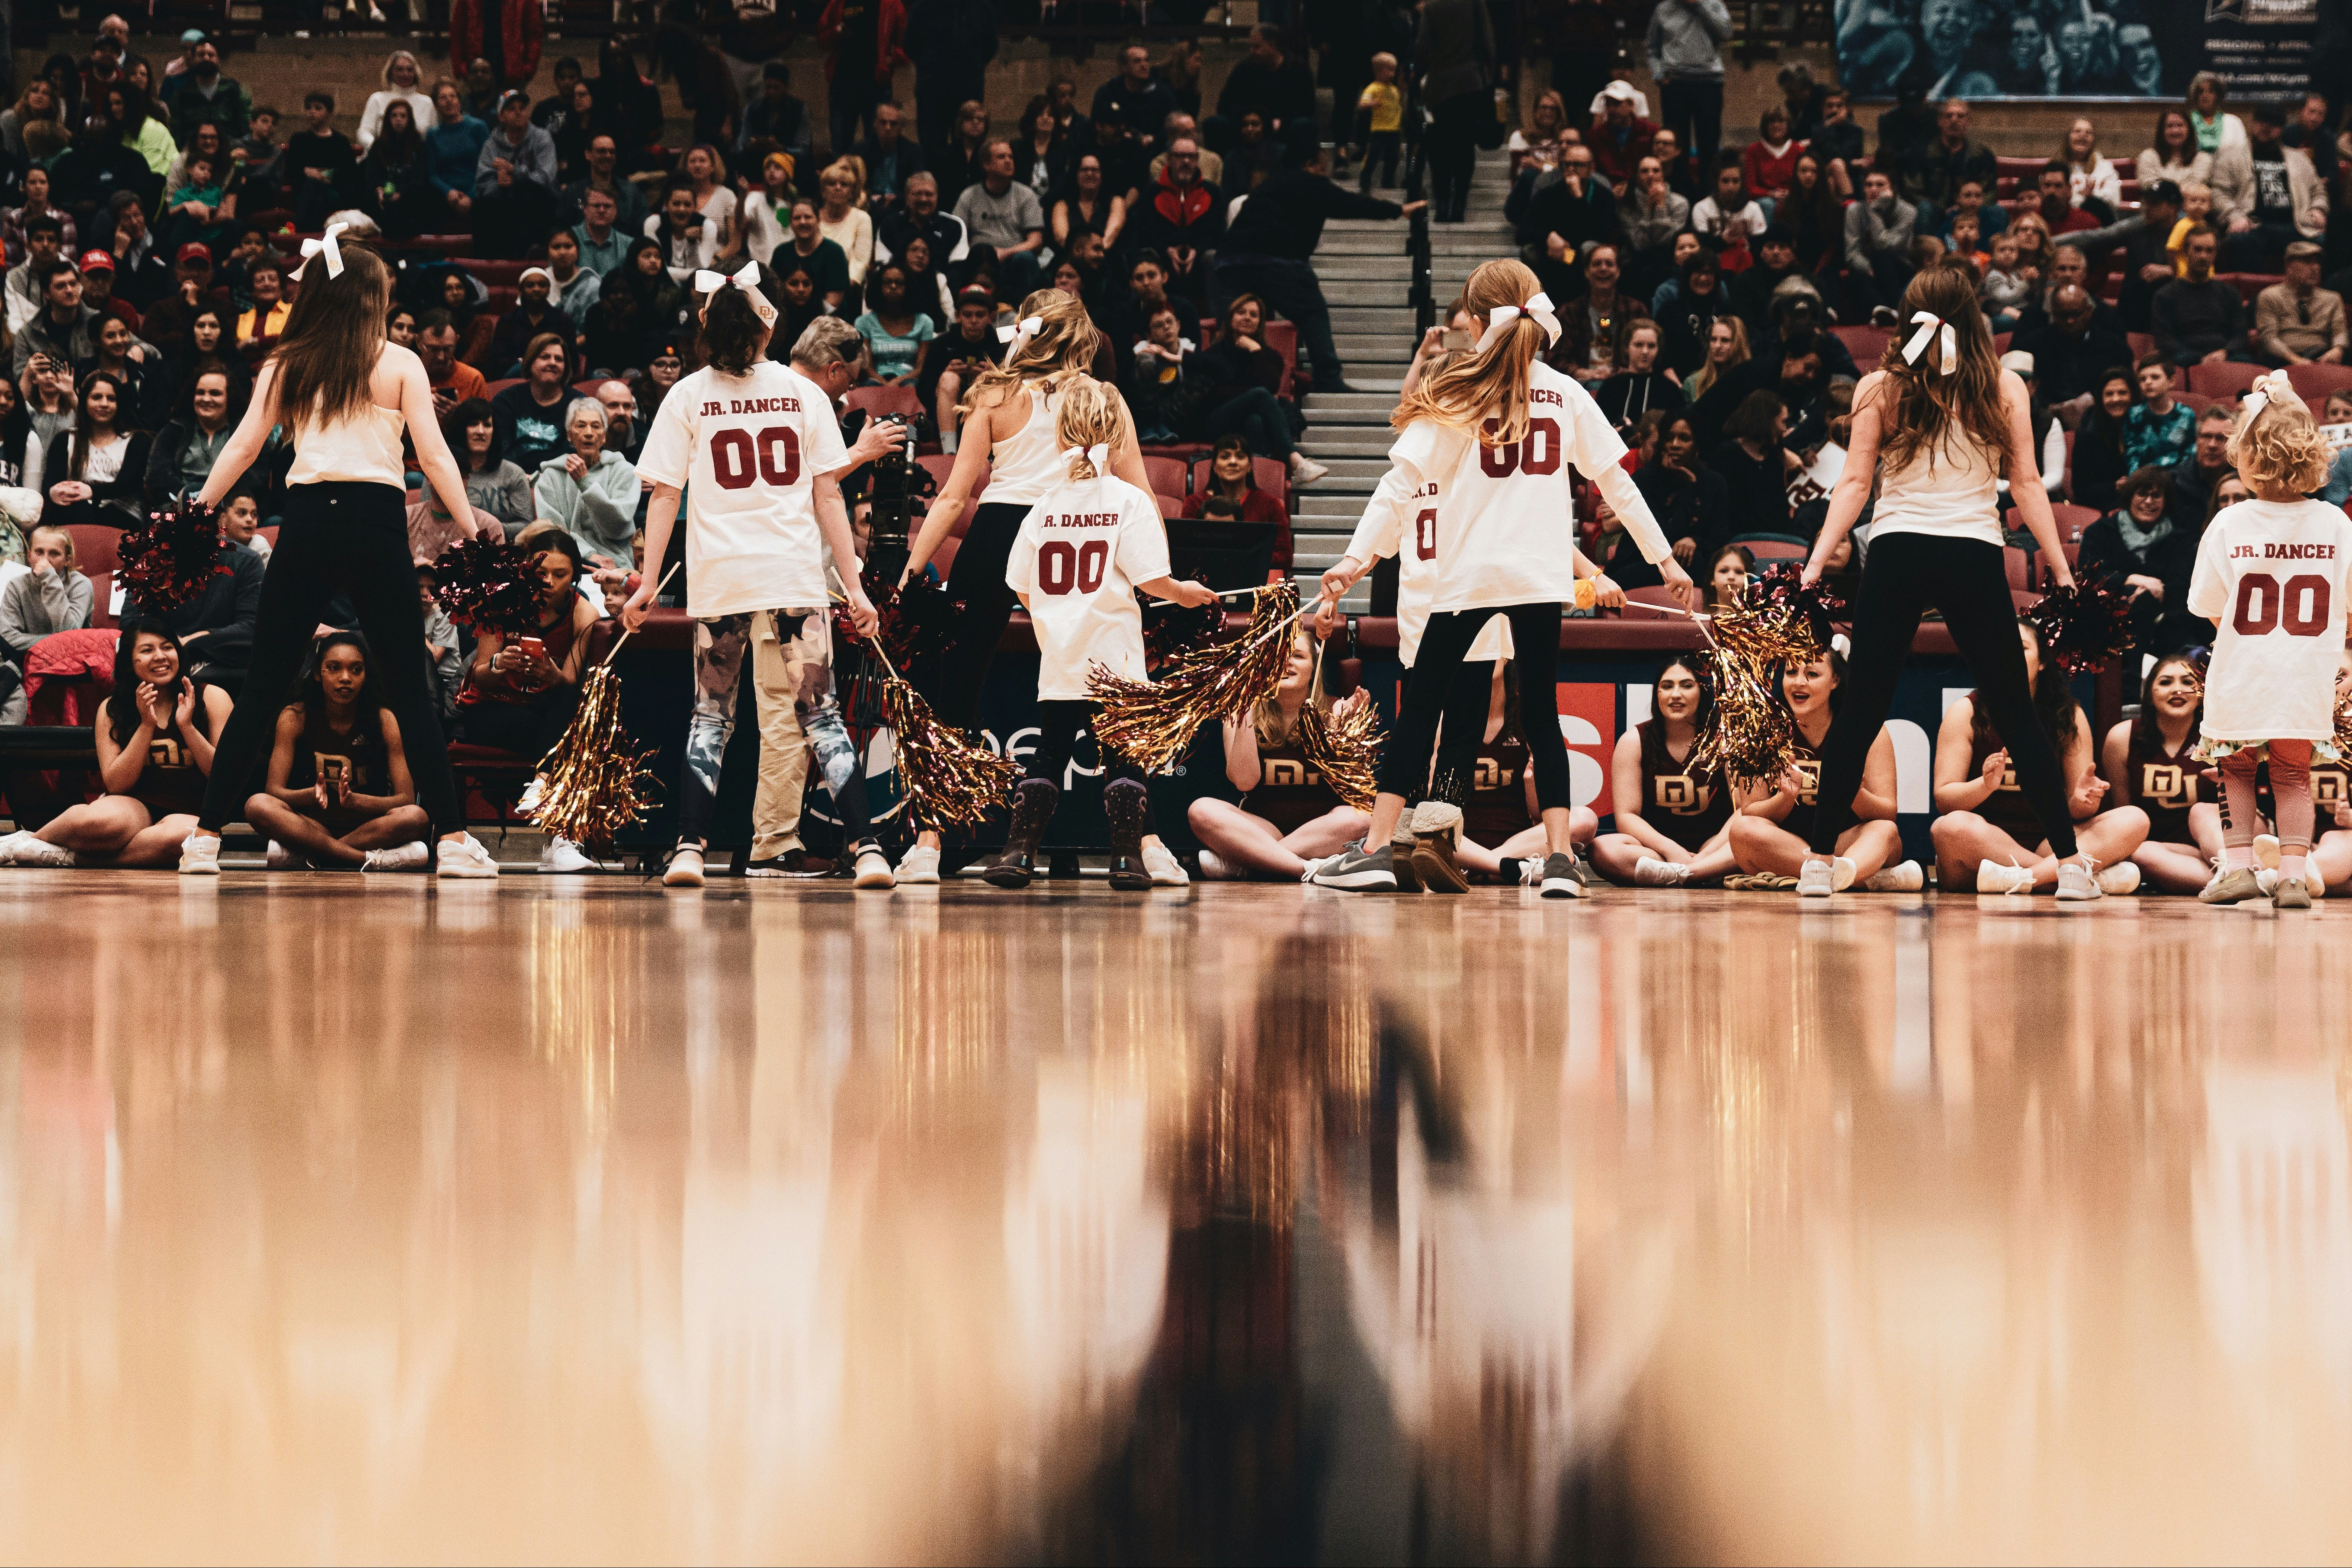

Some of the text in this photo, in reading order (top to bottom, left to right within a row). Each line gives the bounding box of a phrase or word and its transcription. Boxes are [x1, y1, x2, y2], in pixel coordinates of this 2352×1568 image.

[759, 306, 774, 319] DU
[700, 398, 800, 416] JR. DANCER
[710, 426, 800, 490] 00
[1479, 417, 1560, 478] 00
[1042, 514, 1119, 528] R. DANCER
[1039, 540, 1109, 595] 00
[2230, 543, 2335, 559] JR. DANCER
[2233, 573, 2330, 636] 00
[1655, 775, 1710, 816] DU
[2142, 763, 2198, 809] DU
